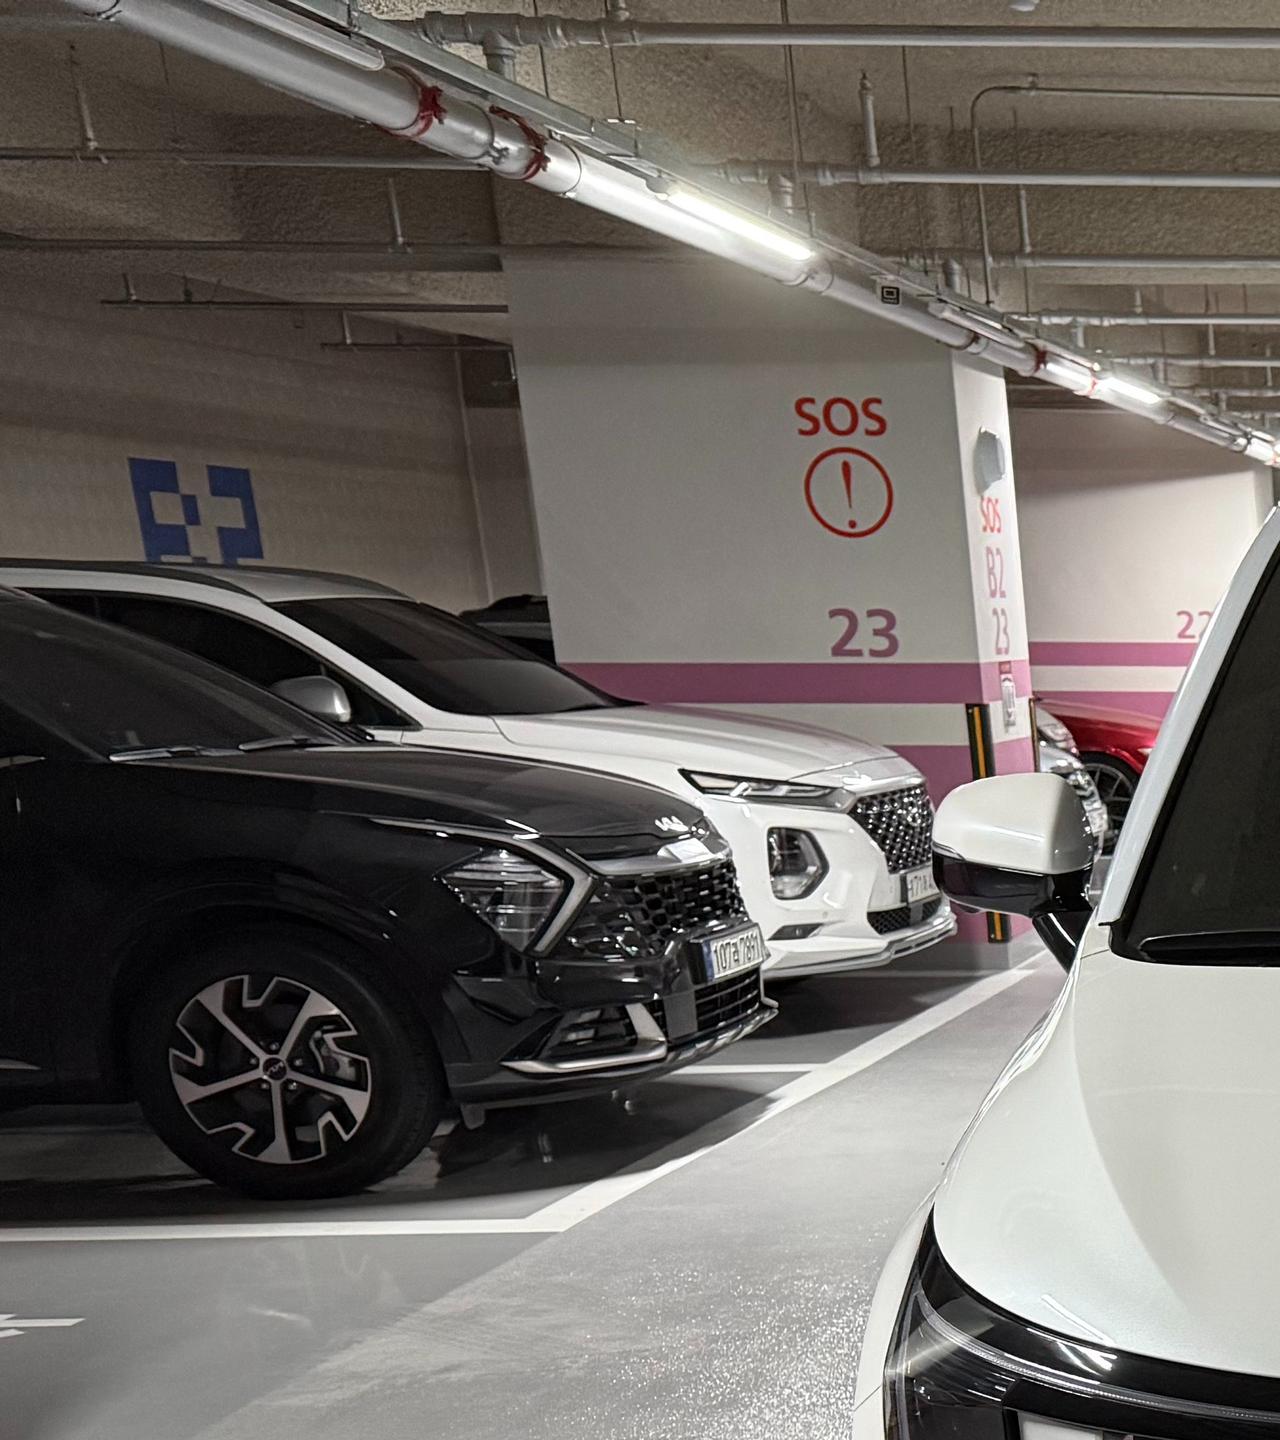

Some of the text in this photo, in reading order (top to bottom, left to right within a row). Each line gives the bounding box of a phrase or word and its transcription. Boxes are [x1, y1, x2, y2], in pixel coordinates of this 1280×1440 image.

[794, 397, 888, 436] SOS
[980, 496, 1002, 533] SOS
[986, 546, 1006, 598] B2
[828, 608, 899, 658] 23
[992, 607, 1010, 655] 23
